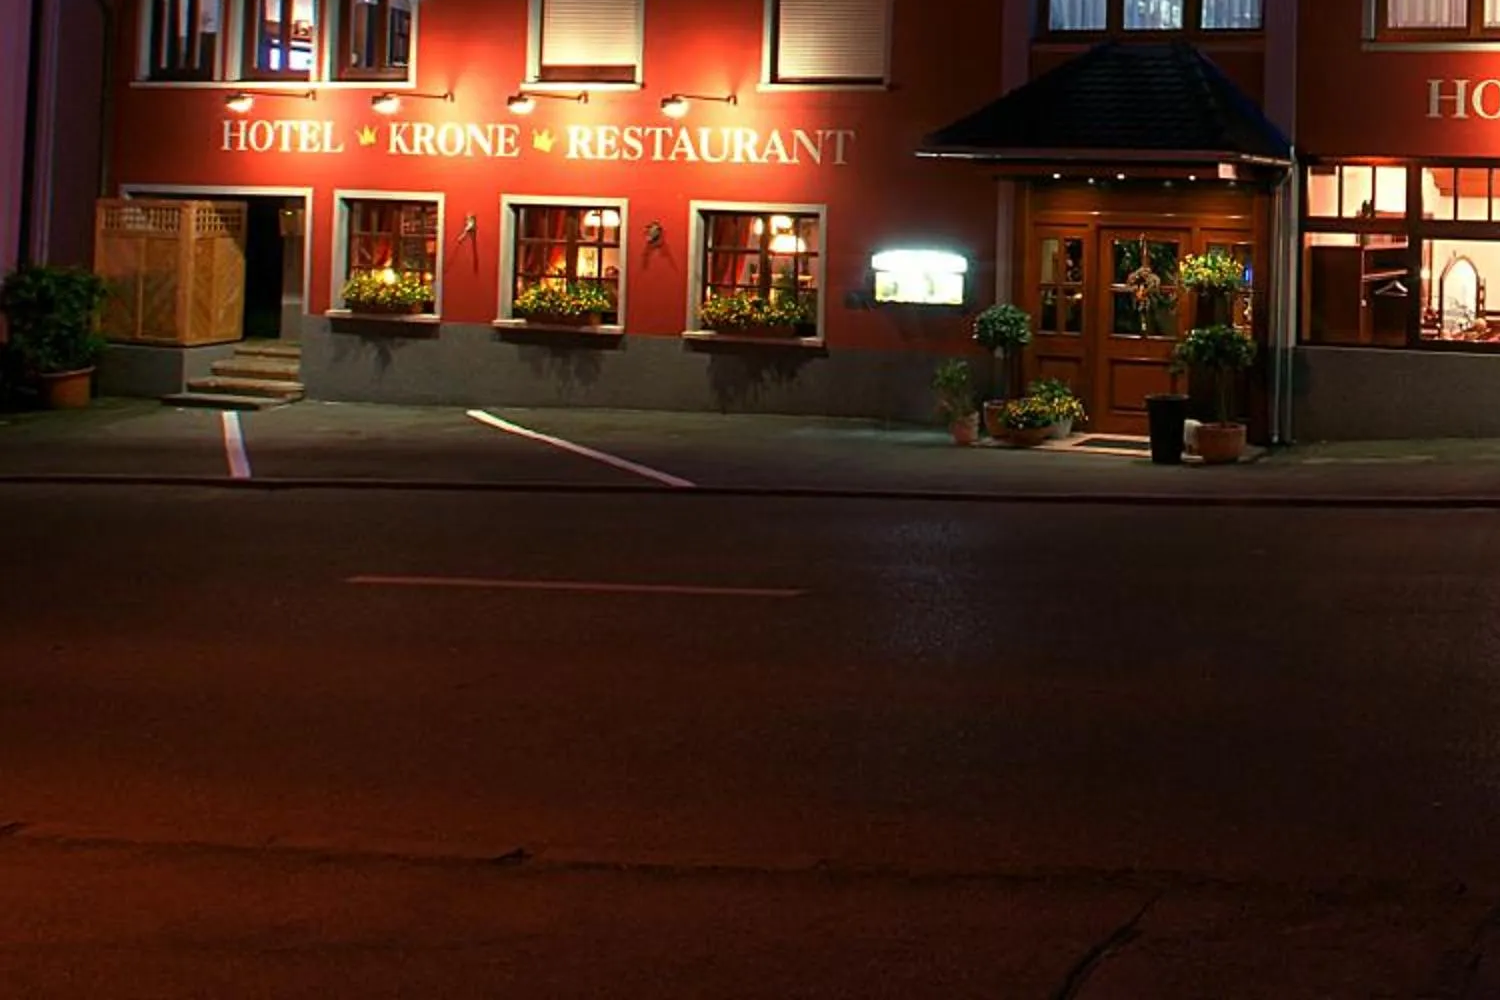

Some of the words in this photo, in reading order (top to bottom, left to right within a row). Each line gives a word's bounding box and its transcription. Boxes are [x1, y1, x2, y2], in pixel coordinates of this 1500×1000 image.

[220, 118, 344, 154] HOTEL
[387, 122, 521, 158] KRONE
[564, 122, 855, 166] RESTAURANT
